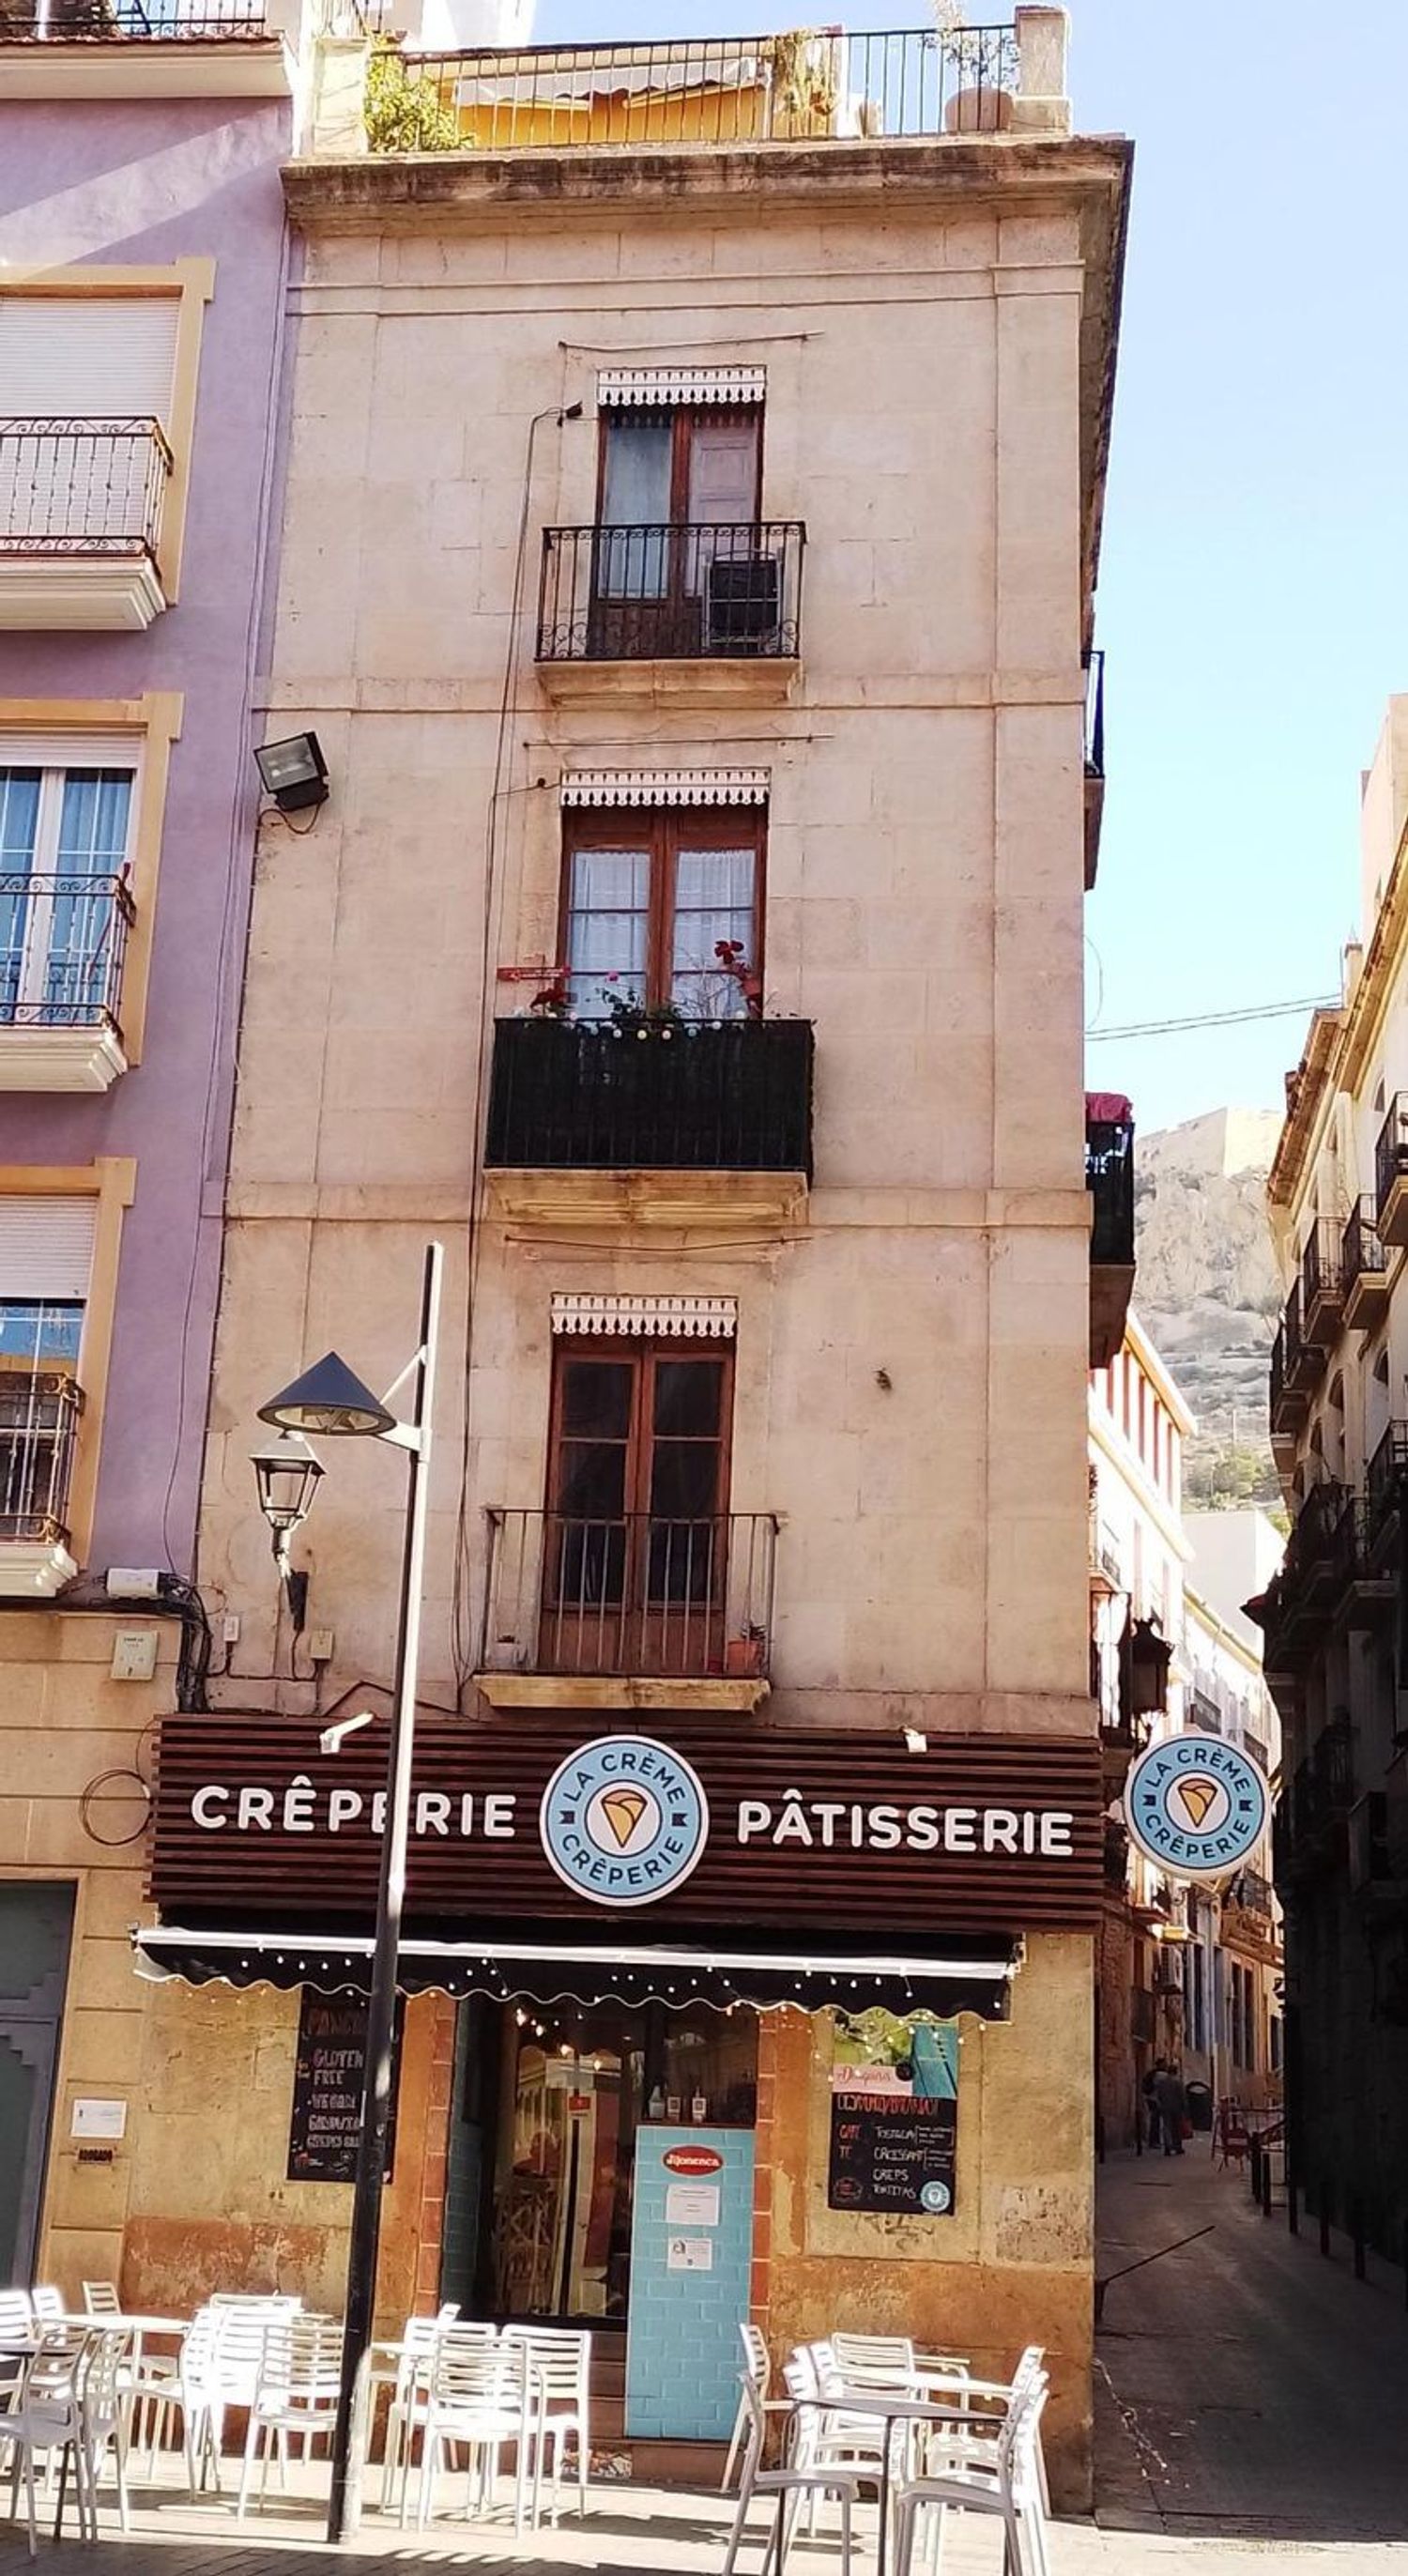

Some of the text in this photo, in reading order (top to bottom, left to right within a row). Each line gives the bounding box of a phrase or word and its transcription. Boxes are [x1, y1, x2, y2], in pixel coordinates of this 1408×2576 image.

[562, 1753, 686, 1804] LA CRÈME
[1144, 1747, 1250, 1793] LA CRÈME
[738, 1788, 1073, 1856] PÂTISSERIE
[1144, 1813, 1250, 1860] CRÊPERIE
[562, 1833, 683, 1885] CRÊPERIE
[314, 2069, 345, 2085] FREE
